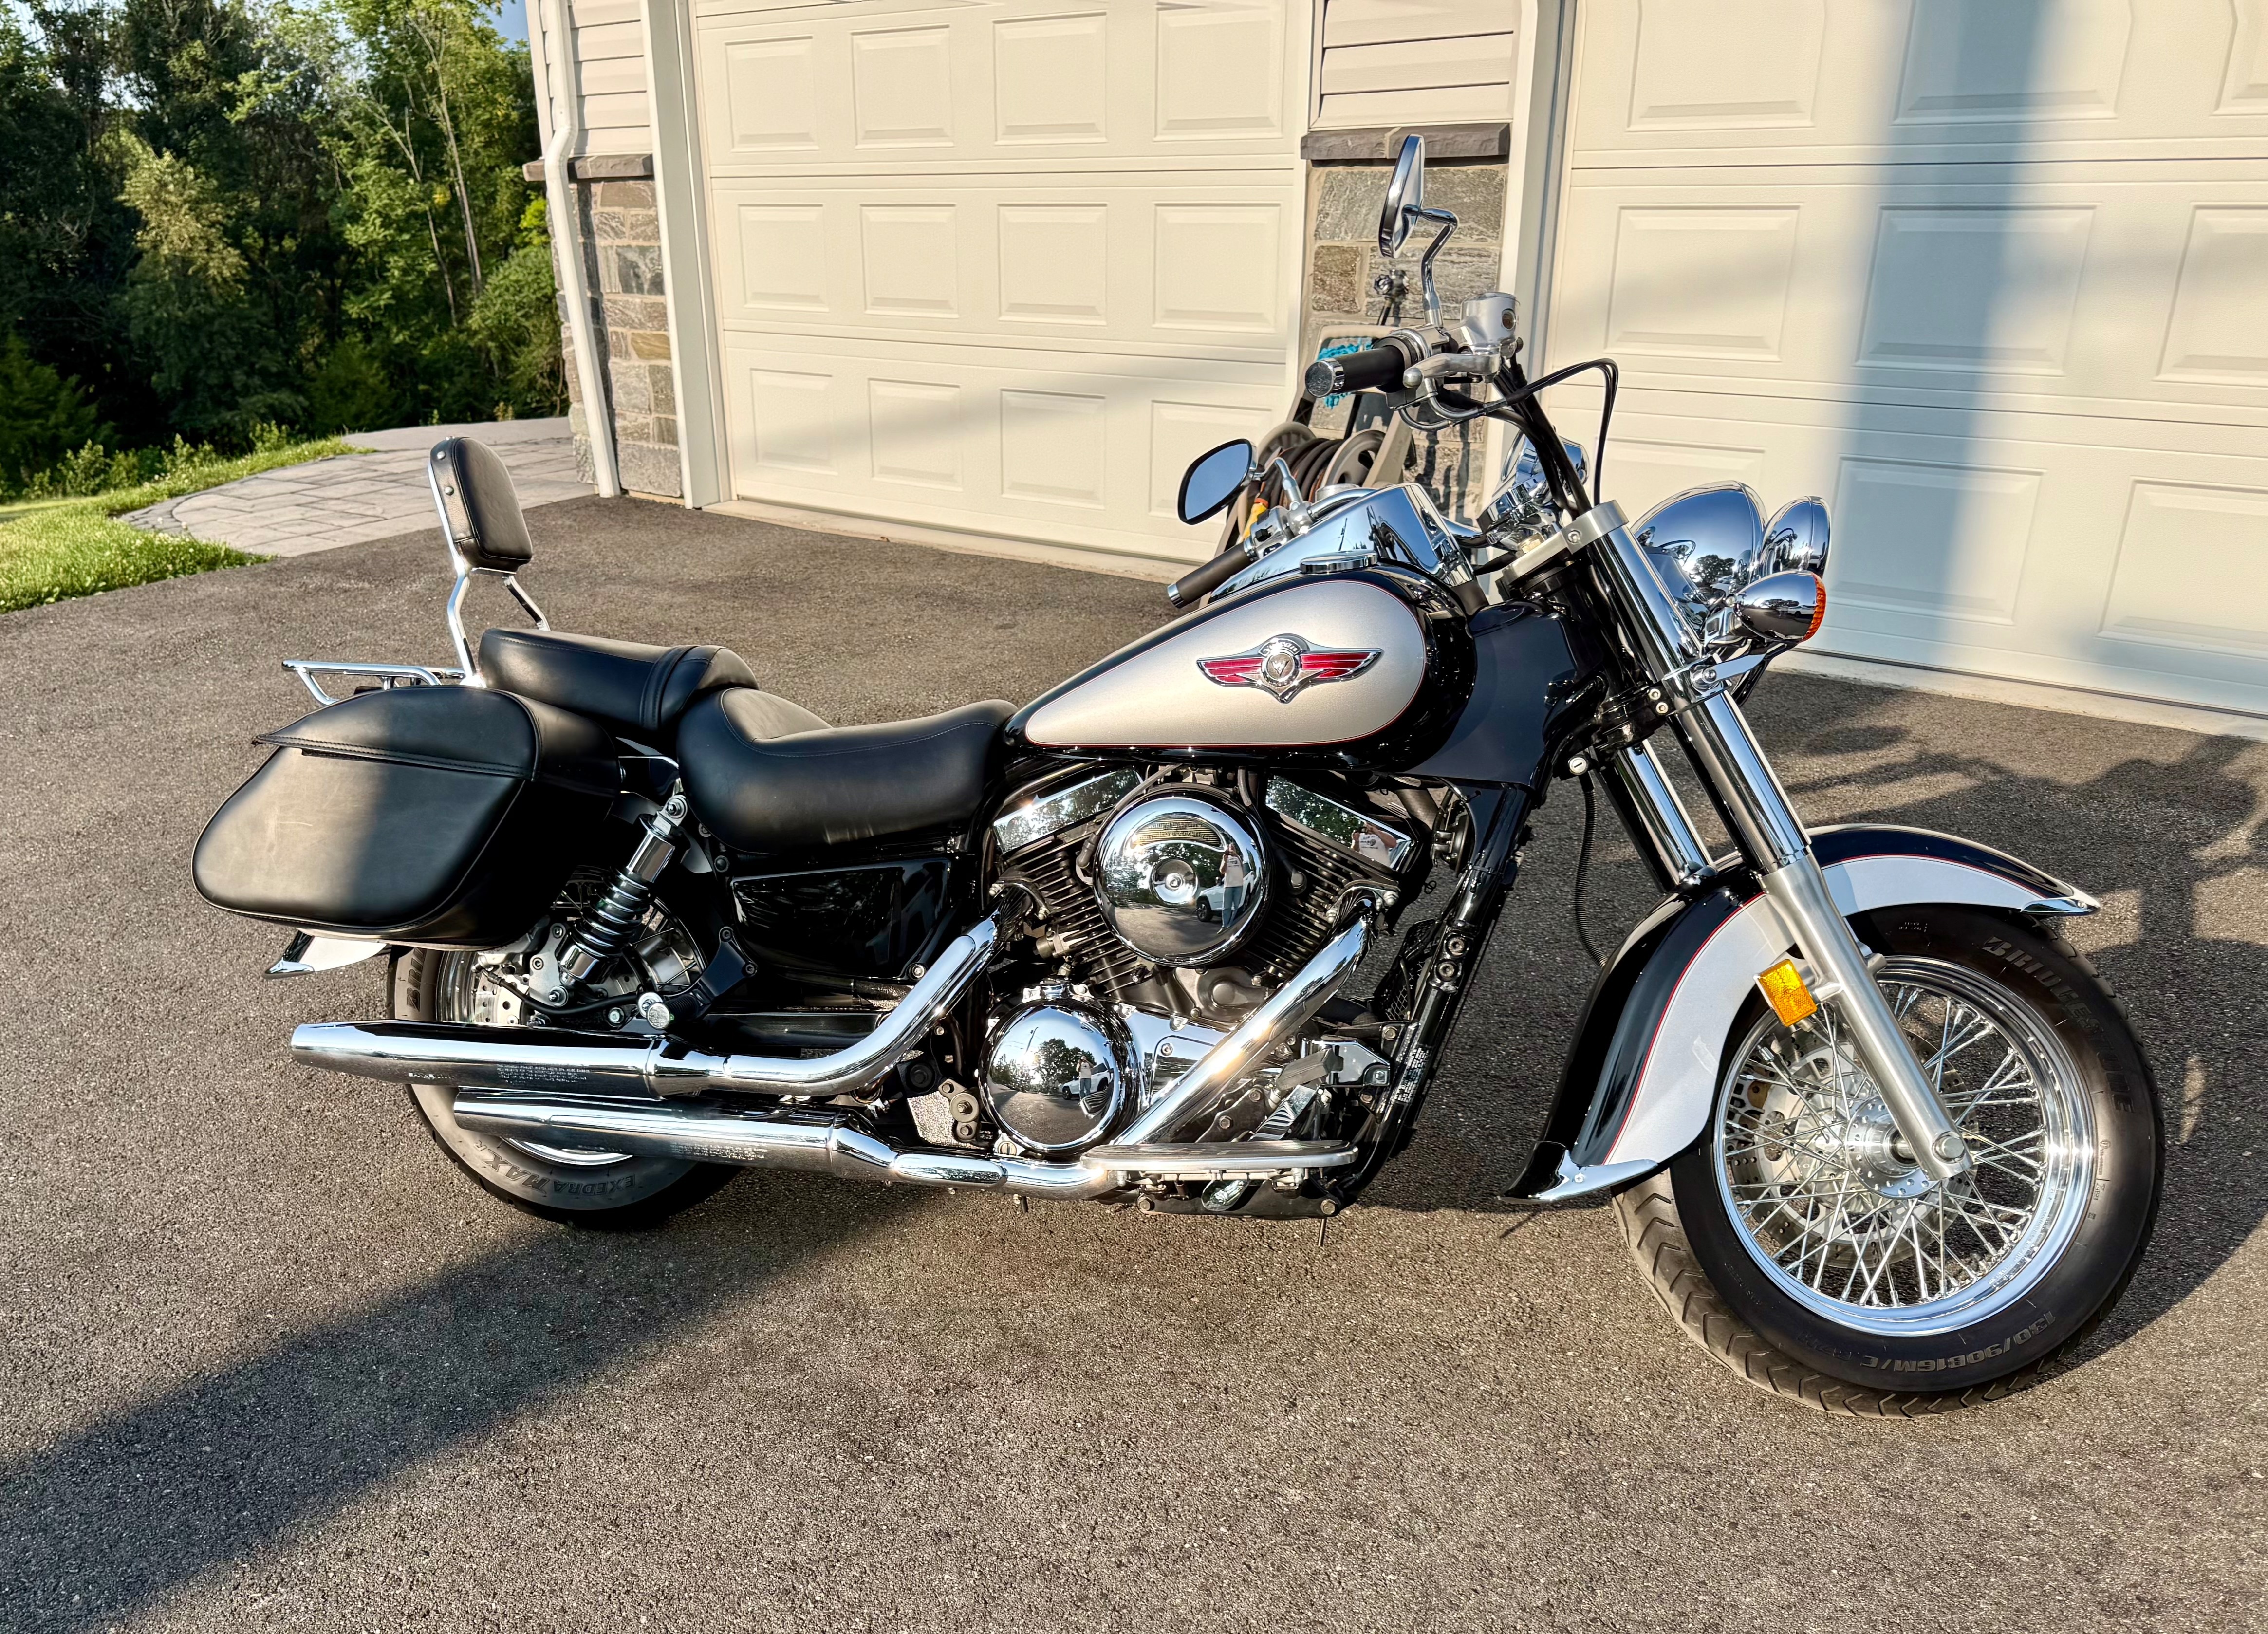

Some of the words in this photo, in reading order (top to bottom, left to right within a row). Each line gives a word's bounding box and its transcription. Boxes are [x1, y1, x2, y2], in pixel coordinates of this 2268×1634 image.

[1981, 936, 2134, 1113] BRIDGESTONE
[483, 1149, 550, 1194] MAX
[553, 1173, 635, 1196] EXEDRA
